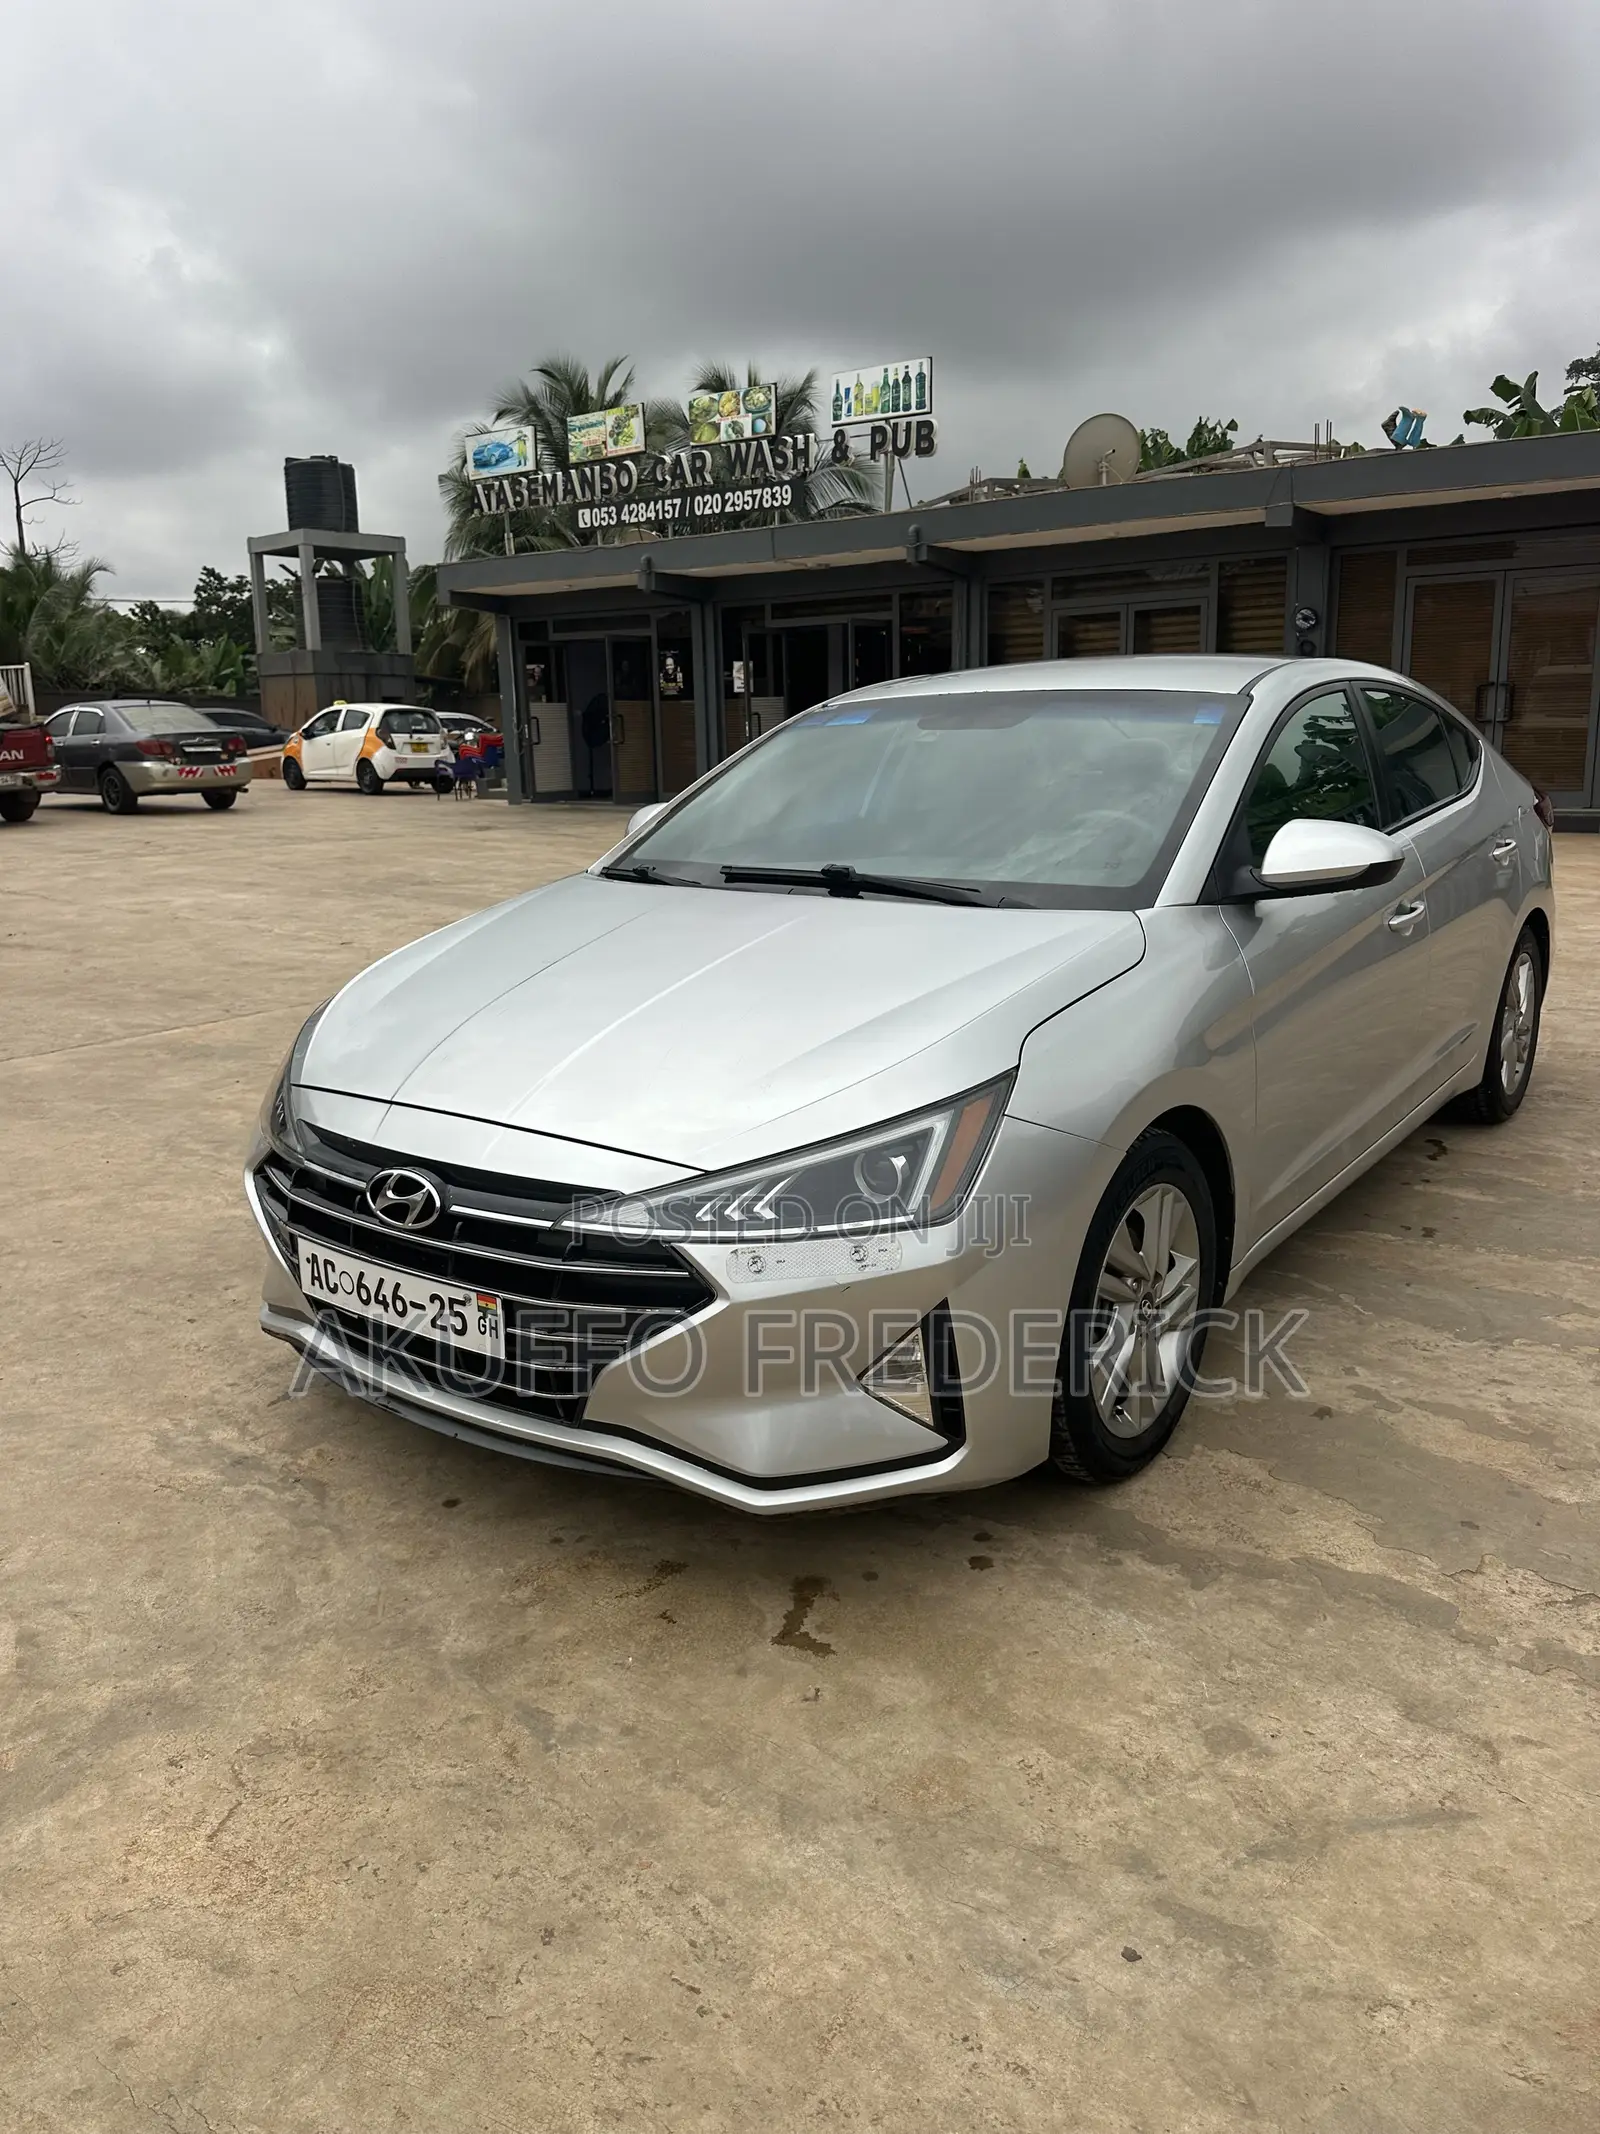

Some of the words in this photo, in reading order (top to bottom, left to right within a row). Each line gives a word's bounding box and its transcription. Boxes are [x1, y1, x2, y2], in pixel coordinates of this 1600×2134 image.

[653, 450, 713, 491] CAR
[722, 433, 815, 481] WASH
[832, 429, 855, 465] &
[870, 419, 937, 462] PUB
[592, 507, 617, 528] 053
[621, 498, 682, 524] 4284157
[694, 494, 722, 516] 020
[724, 485, 792, 513] 2957839
[477, 1315, 499, 1340] GH
